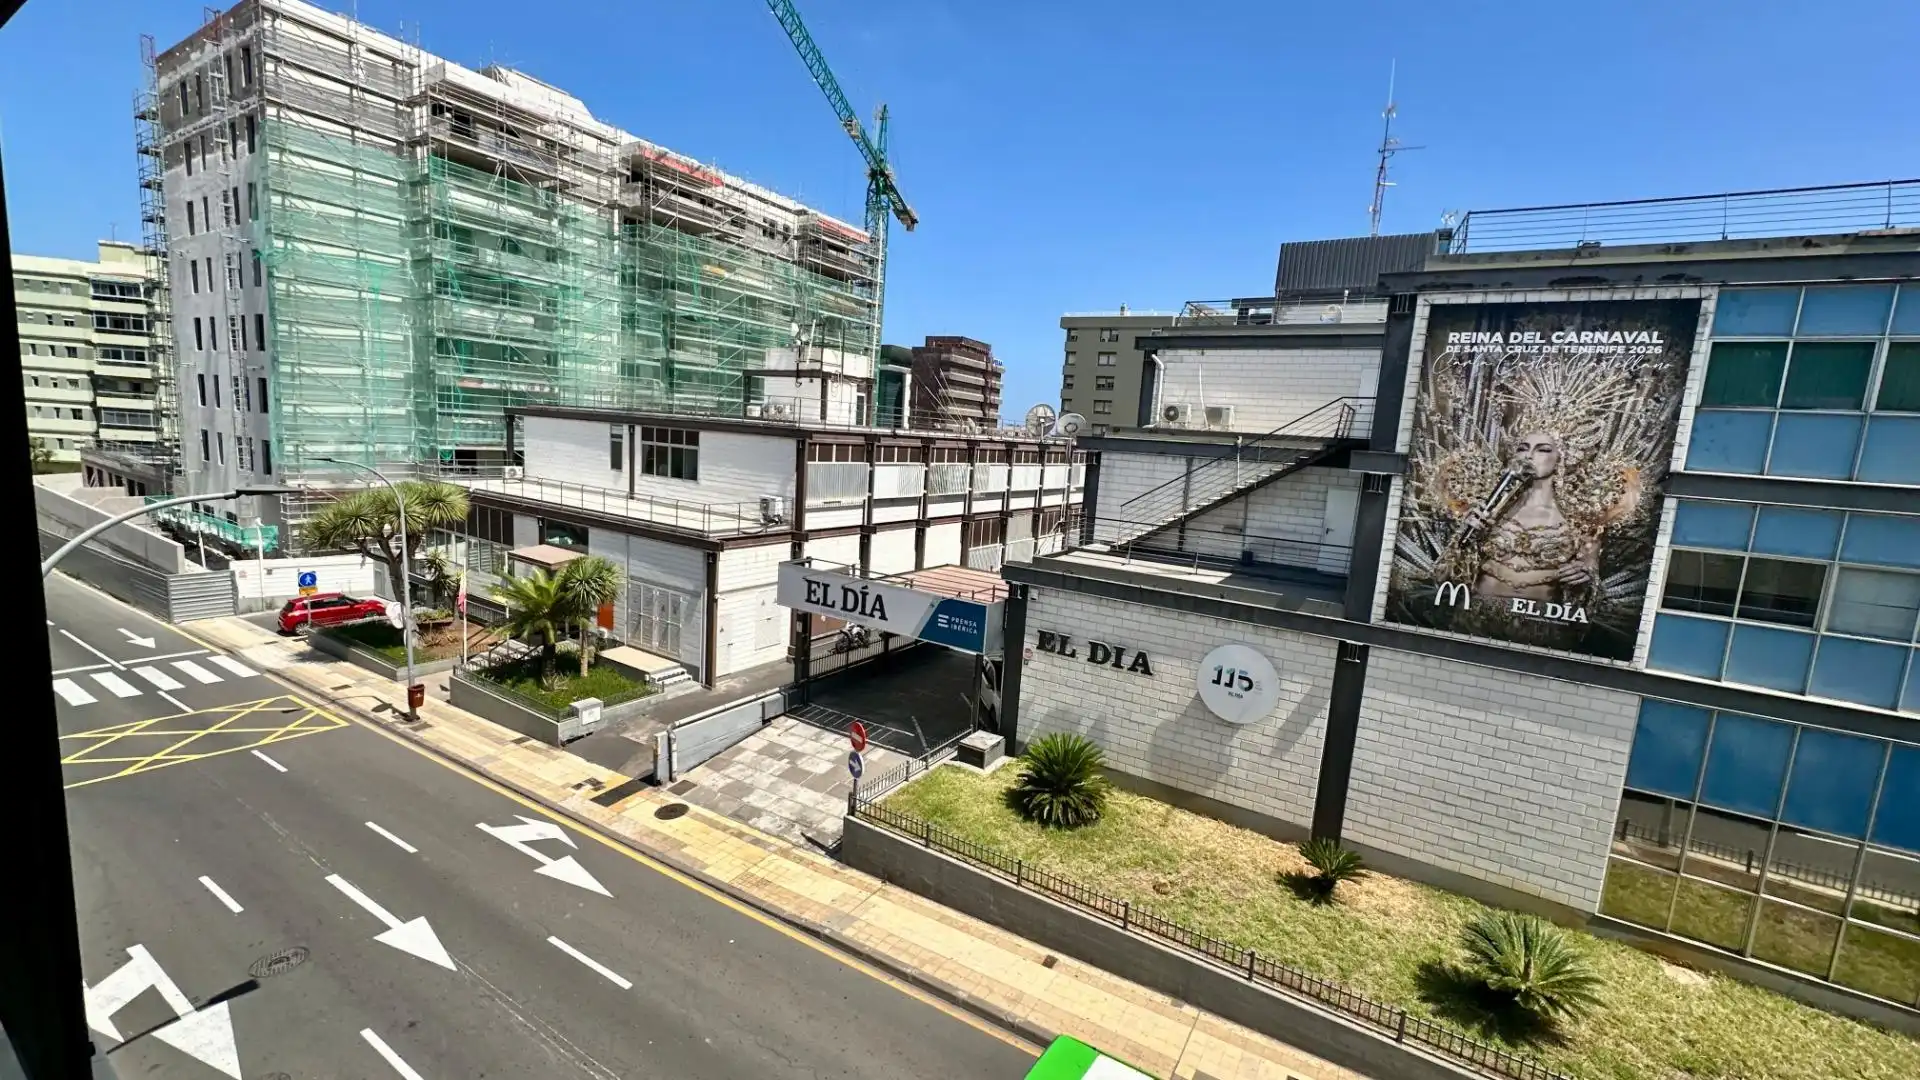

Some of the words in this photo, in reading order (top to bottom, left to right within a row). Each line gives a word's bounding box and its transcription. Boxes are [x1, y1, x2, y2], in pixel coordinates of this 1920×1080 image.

[1446, 345, 1460, 353] DE
[1464, 345, 1502, 353] SANTA
[1506, 345, 1540, 353] CRUZ
[1542, 345, 1559, 353] DE
[1562, 345, 1626, 354] TENERIFE
[1629, 345, 1663, 354] 2026
[1448, 331, 1504, 344] REINA
[1508, 331, 1546, 344] DEL
[1551, 330, 1664, 344] CARNAVAL
[802, 577, 836, 608] EL
[840, 585, 889, 621] DÍA
[1510, 597, 1540, 616] EL
[1544, 602, 1589, 624] DÍA
[1036, 629, 1077, 659] EL
[1086, 639, 1153, 676] DIA
[1211, 664, 1254, 692] 115
